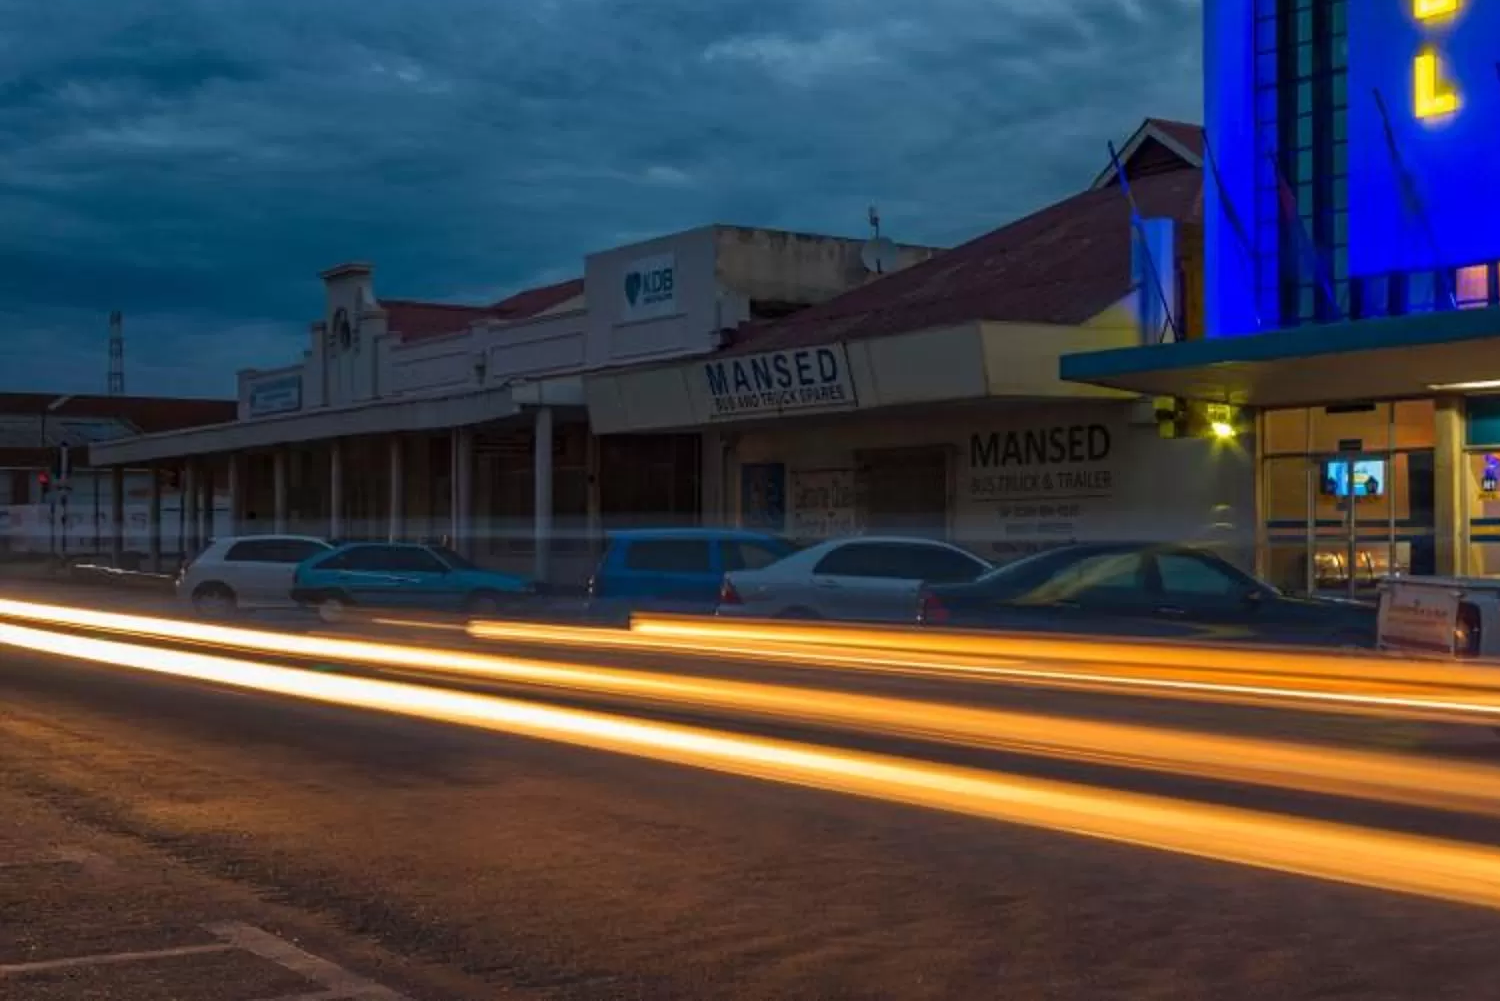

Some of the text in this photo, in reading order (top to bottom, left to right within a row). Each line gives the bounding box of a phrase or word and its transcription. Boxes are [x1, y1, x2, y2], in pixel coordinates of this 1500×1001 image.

[704, 348, 838, 396] MANSED
[760, 388, 798, 407] TRUCK
[799, 384, 845, 404] SPARES
[970, 423, 1111, 468] MANSED
[1056, 469, 1112, 489] TRAILER
